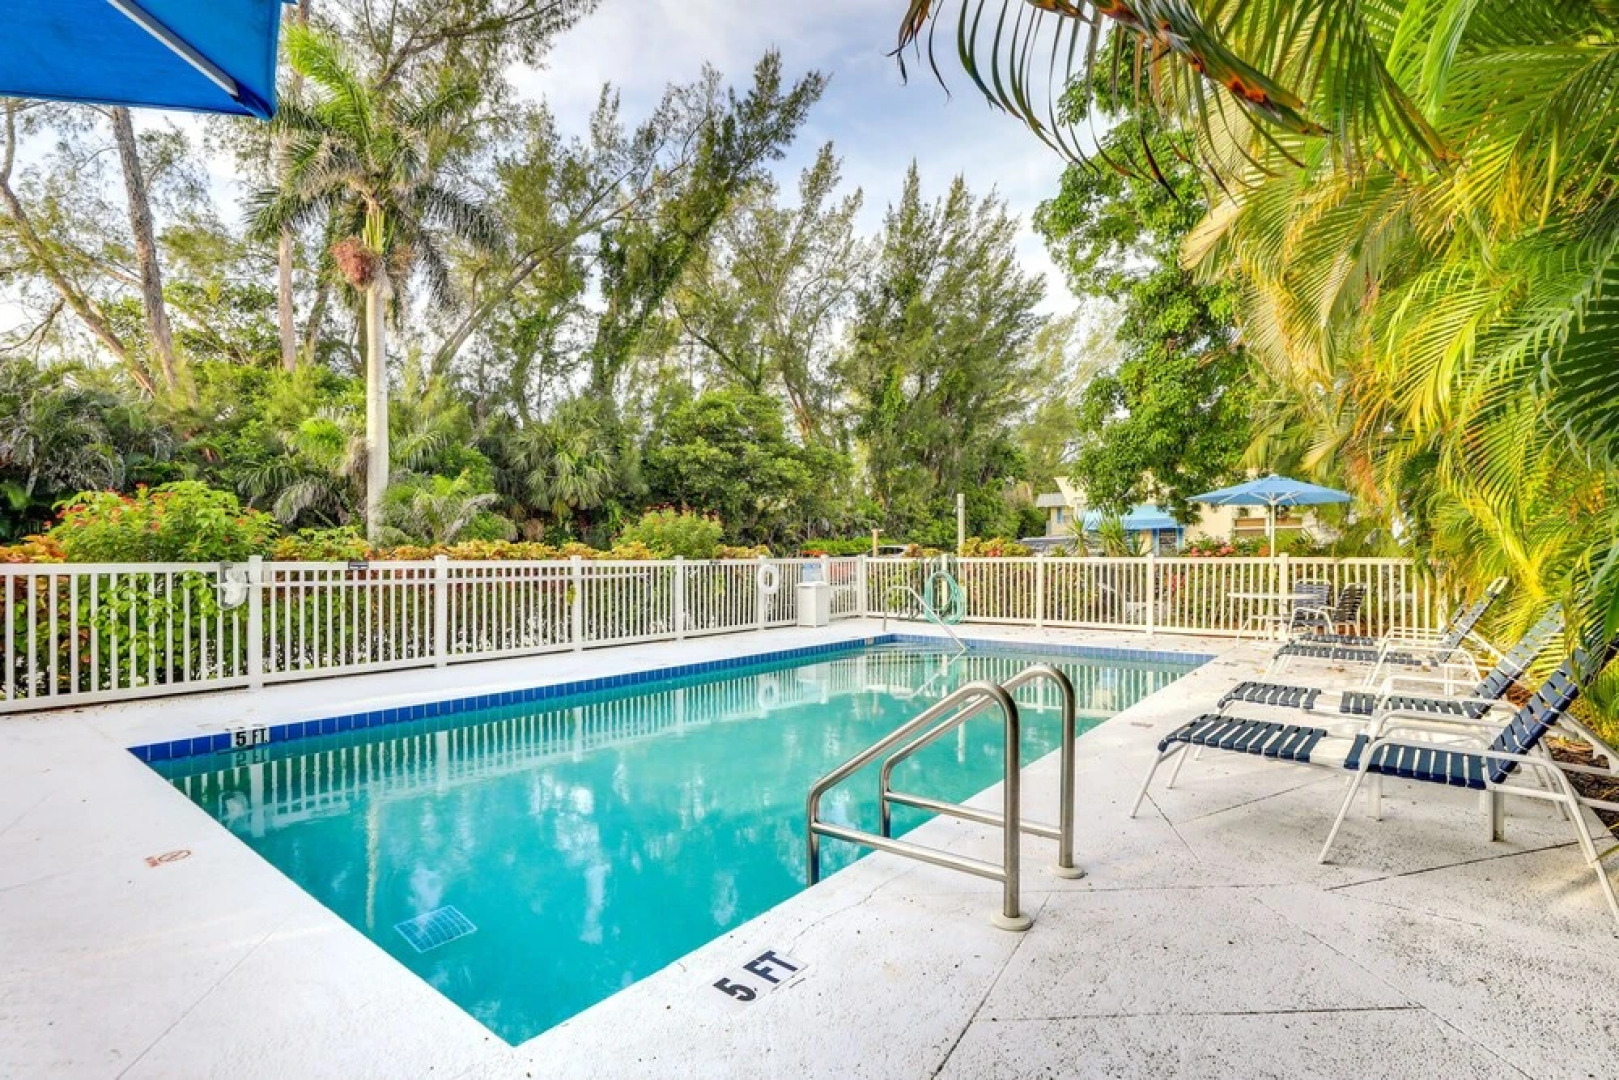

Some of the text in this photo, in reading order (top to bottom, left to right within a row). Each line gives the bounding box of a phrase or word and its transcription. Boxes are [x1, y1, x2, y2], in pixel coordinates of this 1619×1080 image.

[235, 731, 246, 746] 5
[712, 949, 798, 1001] 5 FT
